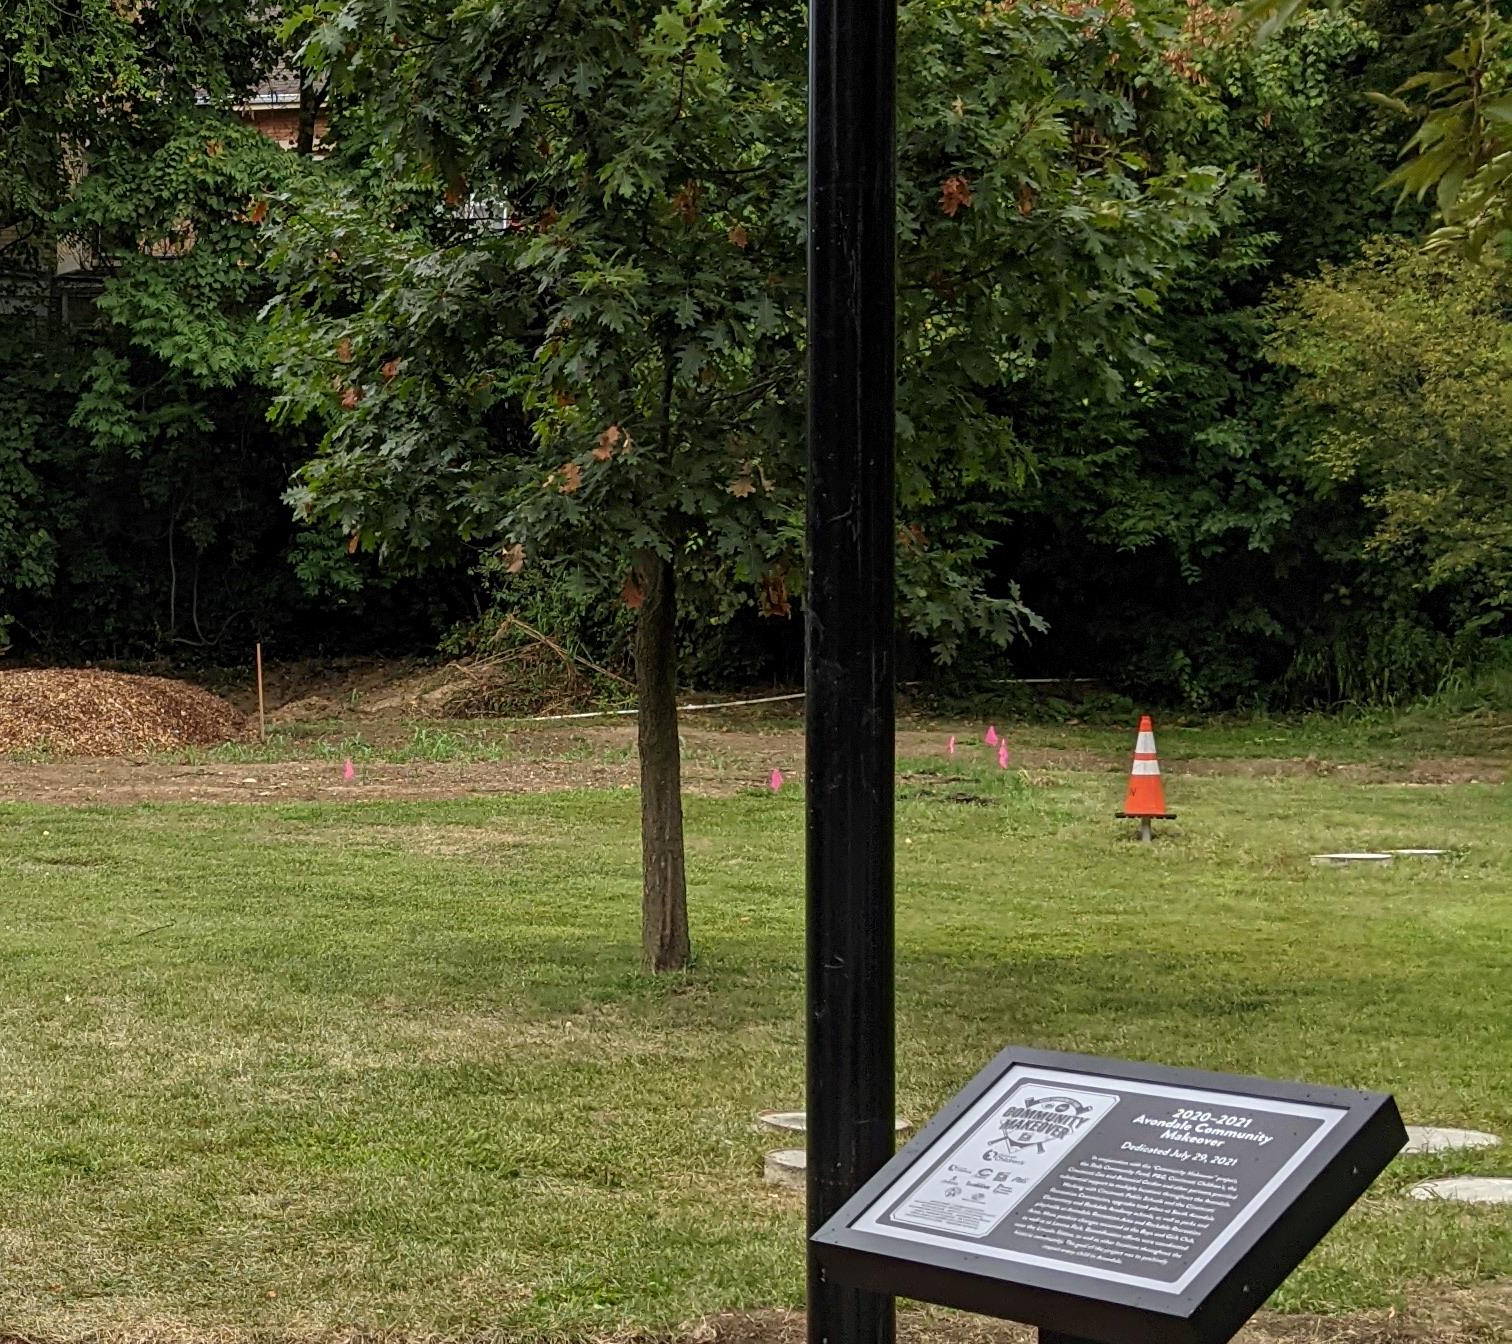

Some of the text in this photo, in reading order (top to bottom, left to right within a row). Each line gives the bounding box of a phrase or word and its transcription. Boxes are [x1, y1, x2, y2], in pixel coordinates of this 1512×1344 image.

[999, 1119, 1069, 1139] MAKEOVER
[1003, 1106, 1089, 1129] COMMUNITY
[1132, 1114, 1274, 1146] Avondale Community
[1160, 1129, 1226, 1147] Makeover
[1121, 1141, 1172, 1156] Dedicated
[1169, 1149, 1190, 1161] July
[1192, 1152, 1208, 1163] 29,
[1210, 1155, 1238, 1167] 2021
